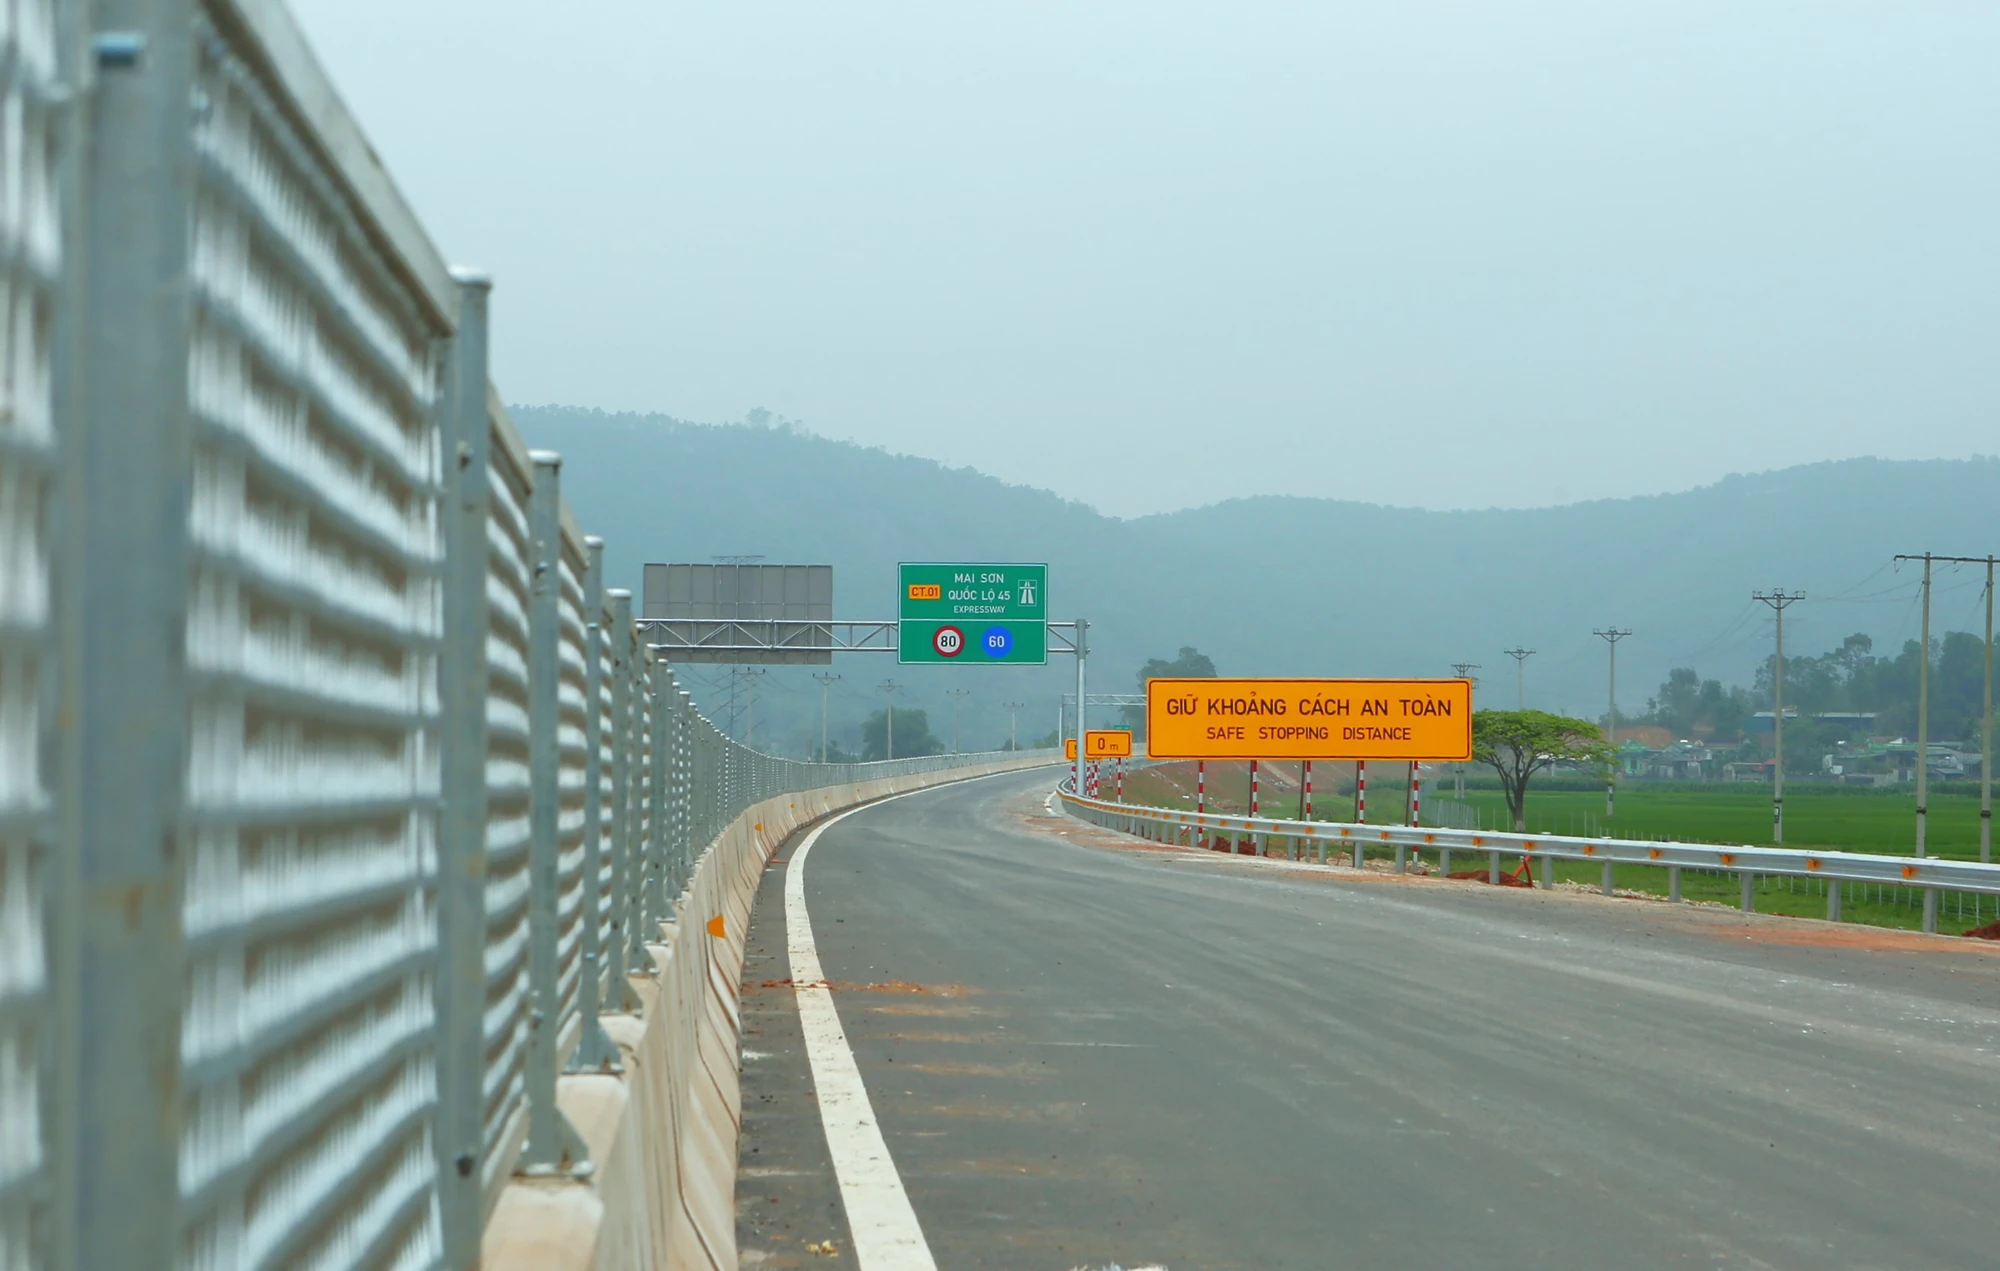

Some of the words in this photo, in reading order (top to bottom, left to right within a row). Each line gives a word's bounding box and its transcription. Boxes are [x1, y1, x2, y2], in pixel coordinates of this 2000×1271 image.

[954, 573, 975, 583] MAI
[980, 573, 1004, 583] SƠN
[911, 586, 938, 597] CT.01
[948, 586, 977, 600] QUỐC
[981, 588, 995, 602] LỘ
[998, 590, 1010, 601] 45
[953, 605, 1005, 613] EXPRESSWAY
[940, 635, 957, 647] 80
[988, 635, 1005, 648] 60
[1166, 693, 1199, 716] GIỮ
[1207, 691, 1287, 716] KHOẢNG
[1298, 692, 1350, 716] CÁCH
[1360, 699, 1389, 717] AN
[1399, 693, 1452, 717] TOÀN
[1206, 726, 1245, 740] SAFE
[1258, 726, 1329, 740] STOPPING
[1342, 727, 1412, 740] DISTANCE
[1097, 737, 1106, 750] 0
[1109, 743, 1119, 751] m
